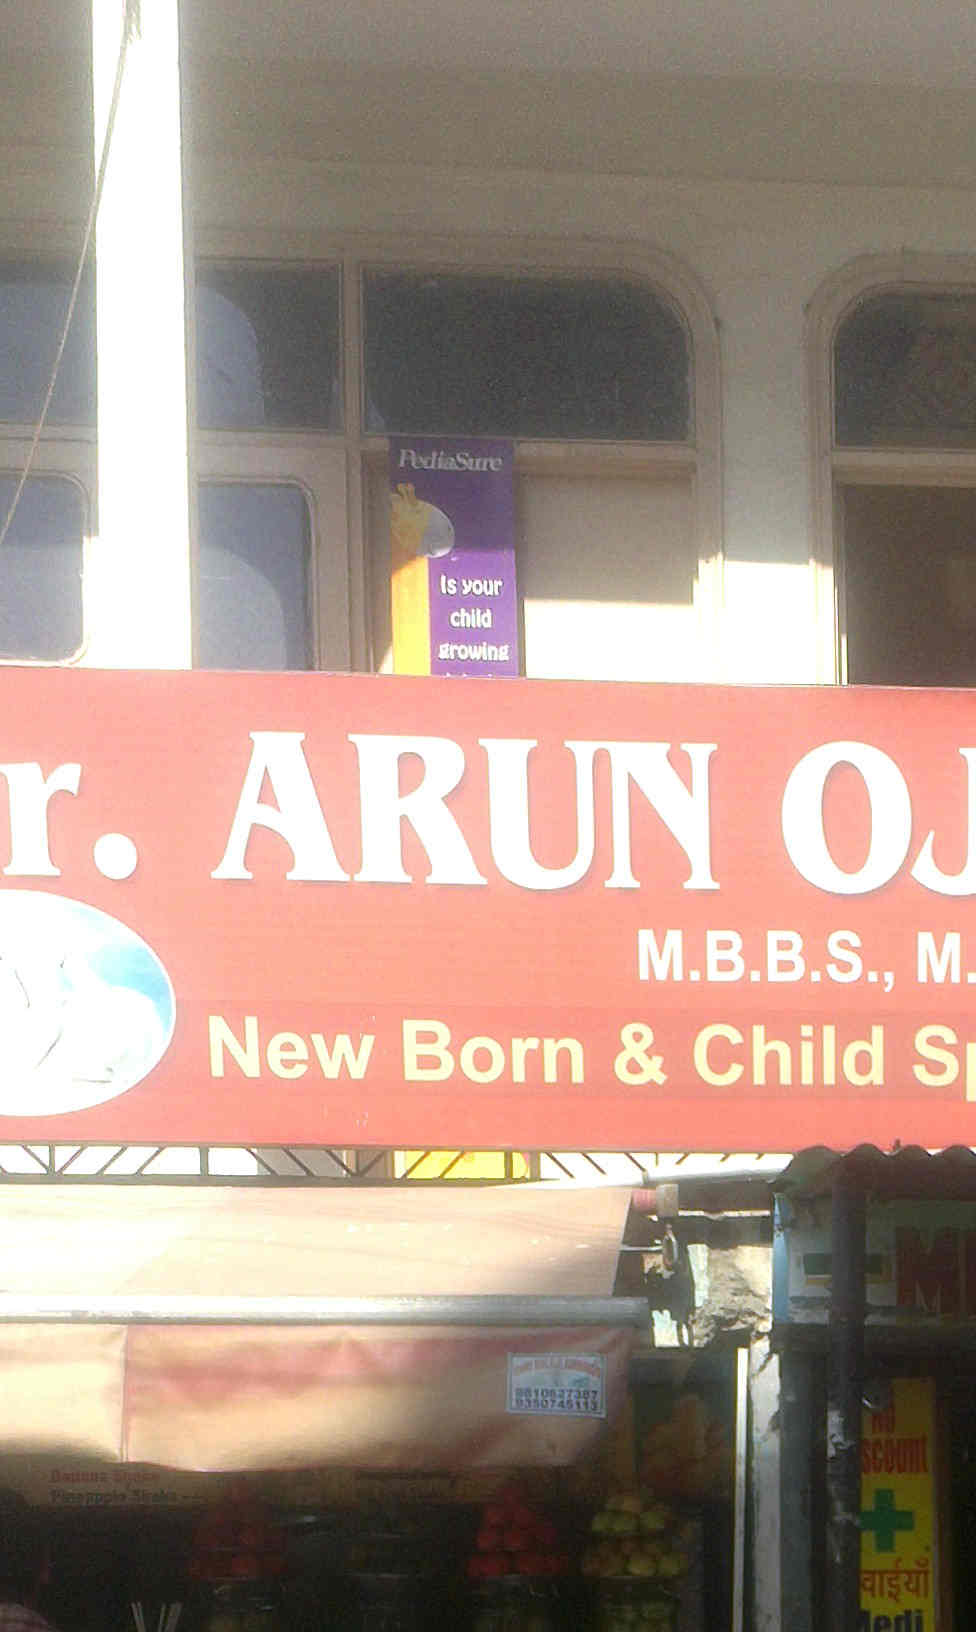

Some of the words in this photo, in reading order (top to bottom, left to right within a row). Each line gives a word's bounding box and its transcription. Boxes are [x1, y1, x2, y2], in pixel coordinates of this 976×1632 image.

[400, 449, 503, 472] PediaSure
[440, 575, 456, 595] Is
[462, 579, 503, 597] your
[450, 608, 492, 629] child
[438, 642, 510, 662] growing
[211, 730, 720, 891] ARUN
[638, 928, 895, 992] M.B.B.S.,
[208, 1014, 376, 1080] New
[402, 1018, 586, 1085] Born
[613, 1022, 668, 1086] &
[692, 1023, 885, 1088] Child
